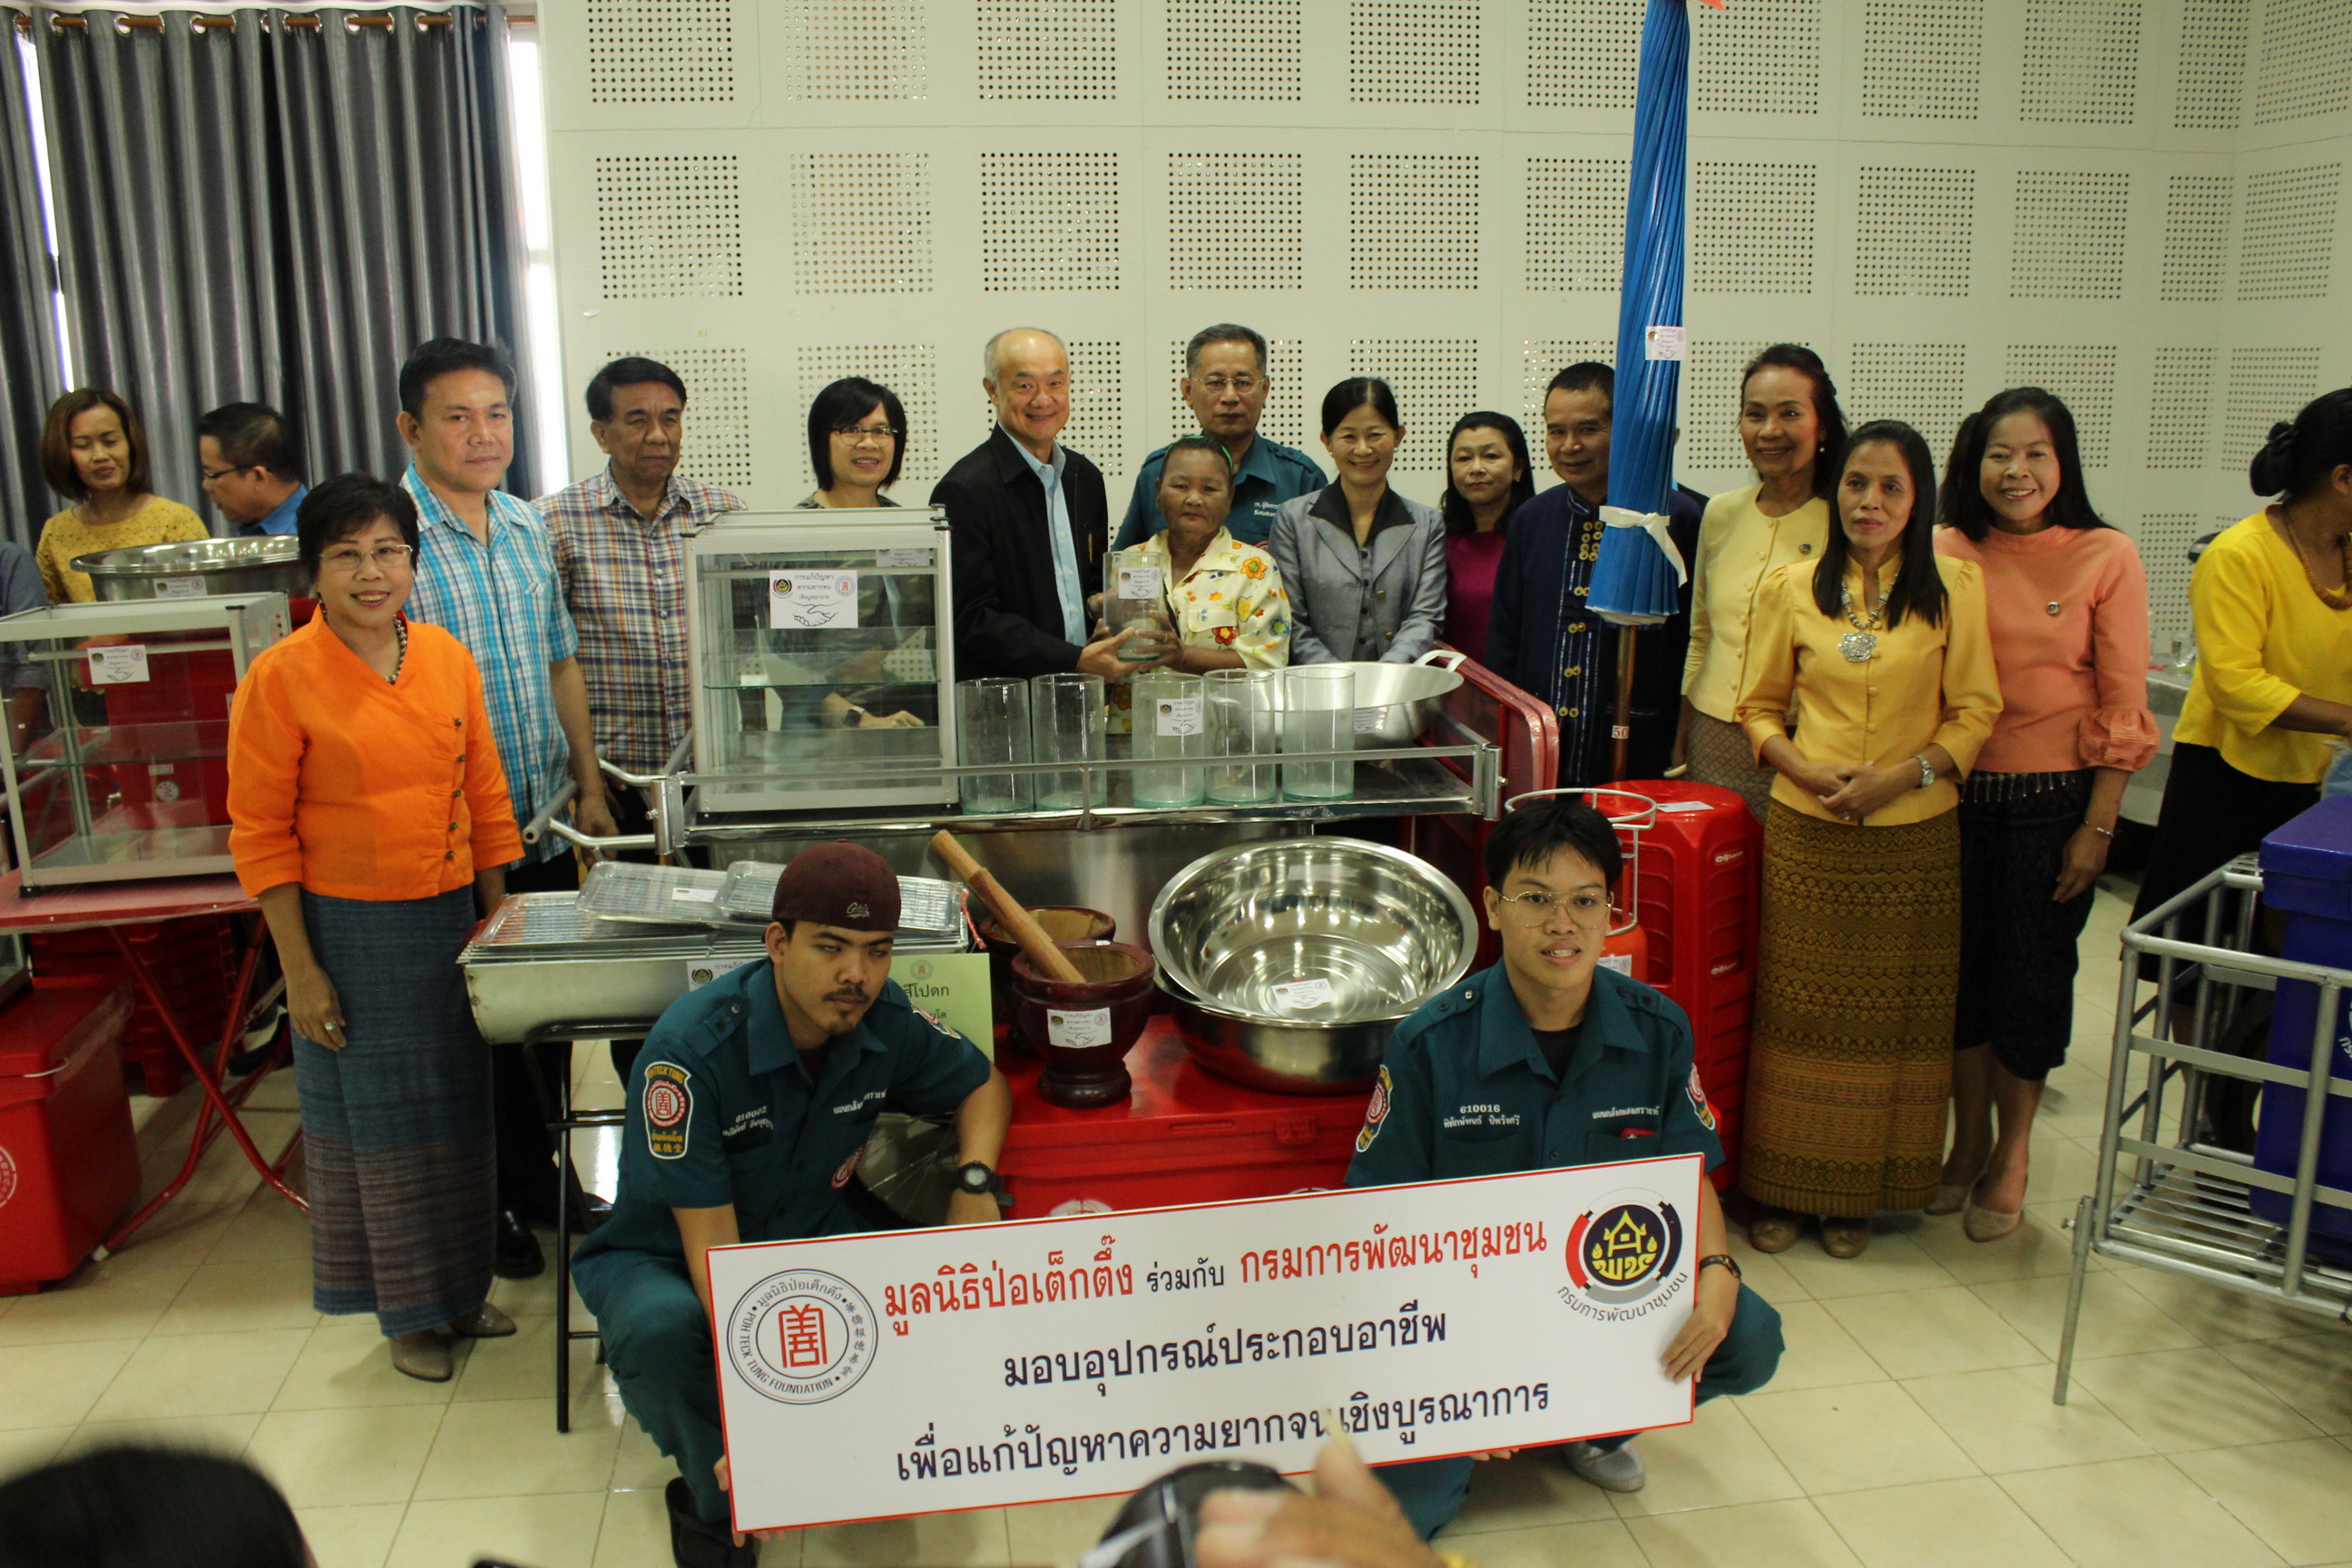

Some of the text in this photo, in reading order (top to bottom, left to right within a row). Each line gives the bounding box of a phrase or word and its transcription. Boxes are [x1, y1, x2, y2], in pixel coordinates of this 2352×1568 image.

[1613, 727, 1629, 738] 50
[1459, 1104, 1501, 1114] 610016
[885, 1222, 1547, 1336] มูลนิธิป่อเต็กตึ๊ง ร่วมกับ กรมการพัฒนาชุมชน
[1556, 1271, 1689, 1322] กรมการพัฒนาชุมชน
[740, 1312, 834, 1395] POH TECK TUNG FOUNDATION
[1004, 1298, 1446, 1397] มอบอุปกรณ์ประกอบอาชีพ
